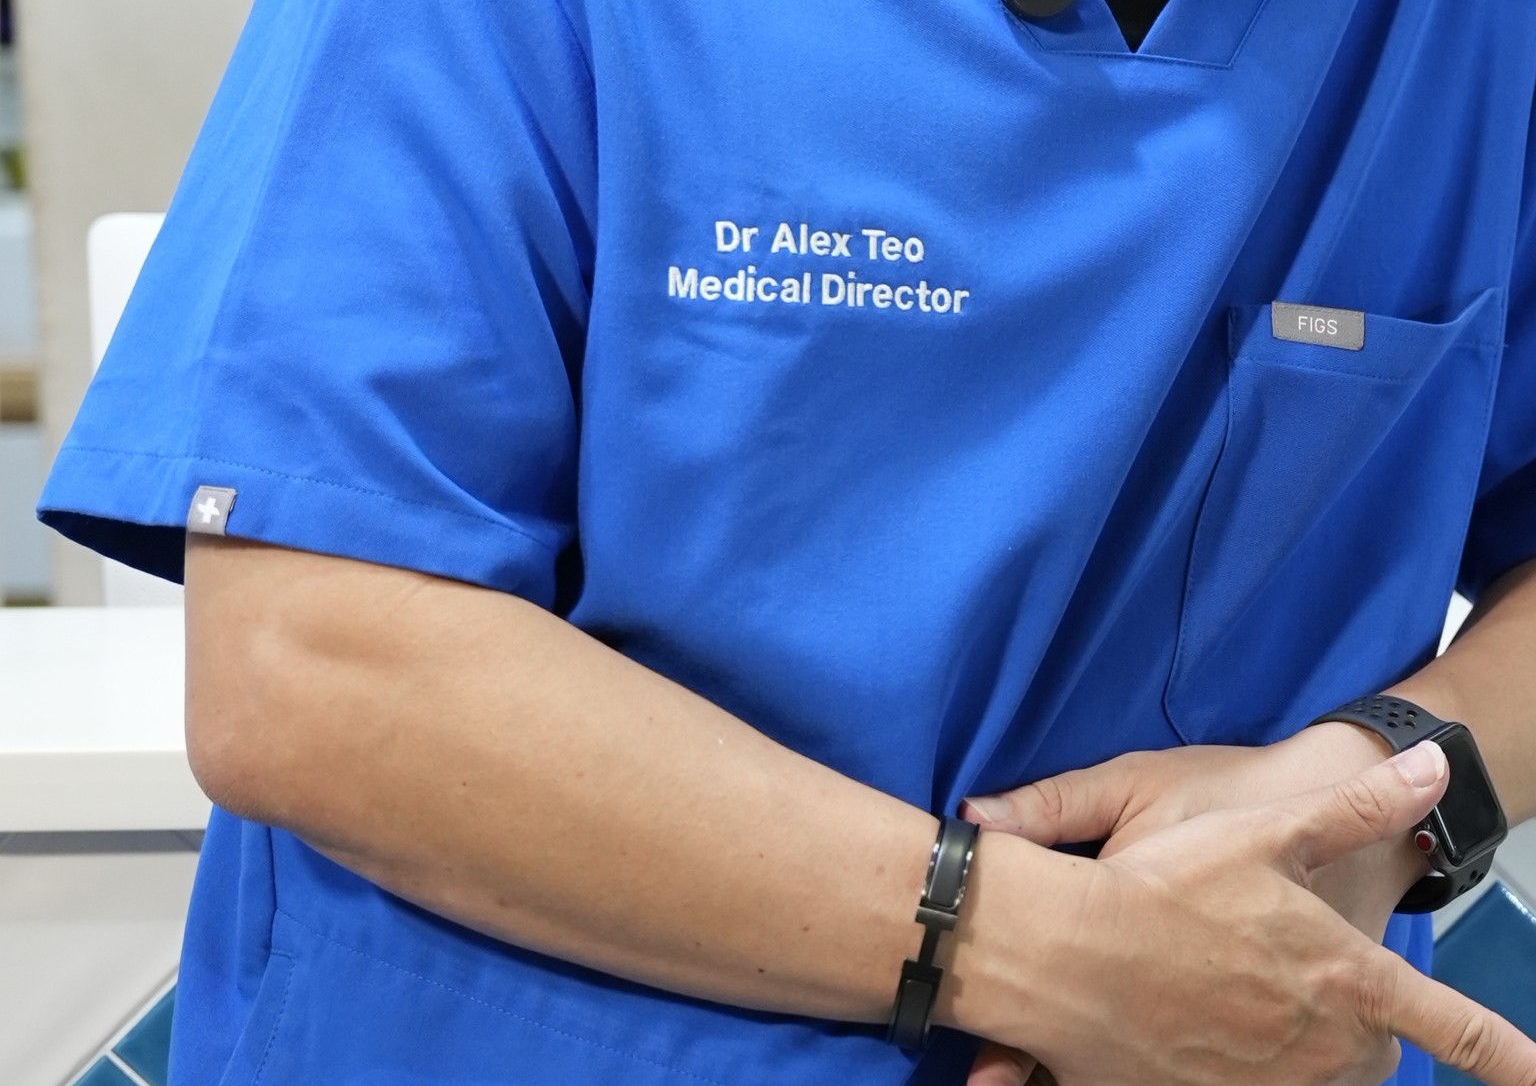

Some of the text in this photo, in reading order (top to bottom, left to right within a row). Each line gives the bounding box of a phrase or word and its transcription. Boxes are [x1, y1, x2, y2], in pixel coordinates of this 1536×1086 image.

[715, 220, 925, 263] Dr Alex Teo
[668, 265, 970, 314] Medical Director
[1298, 315, 1338, 335] FIGS
